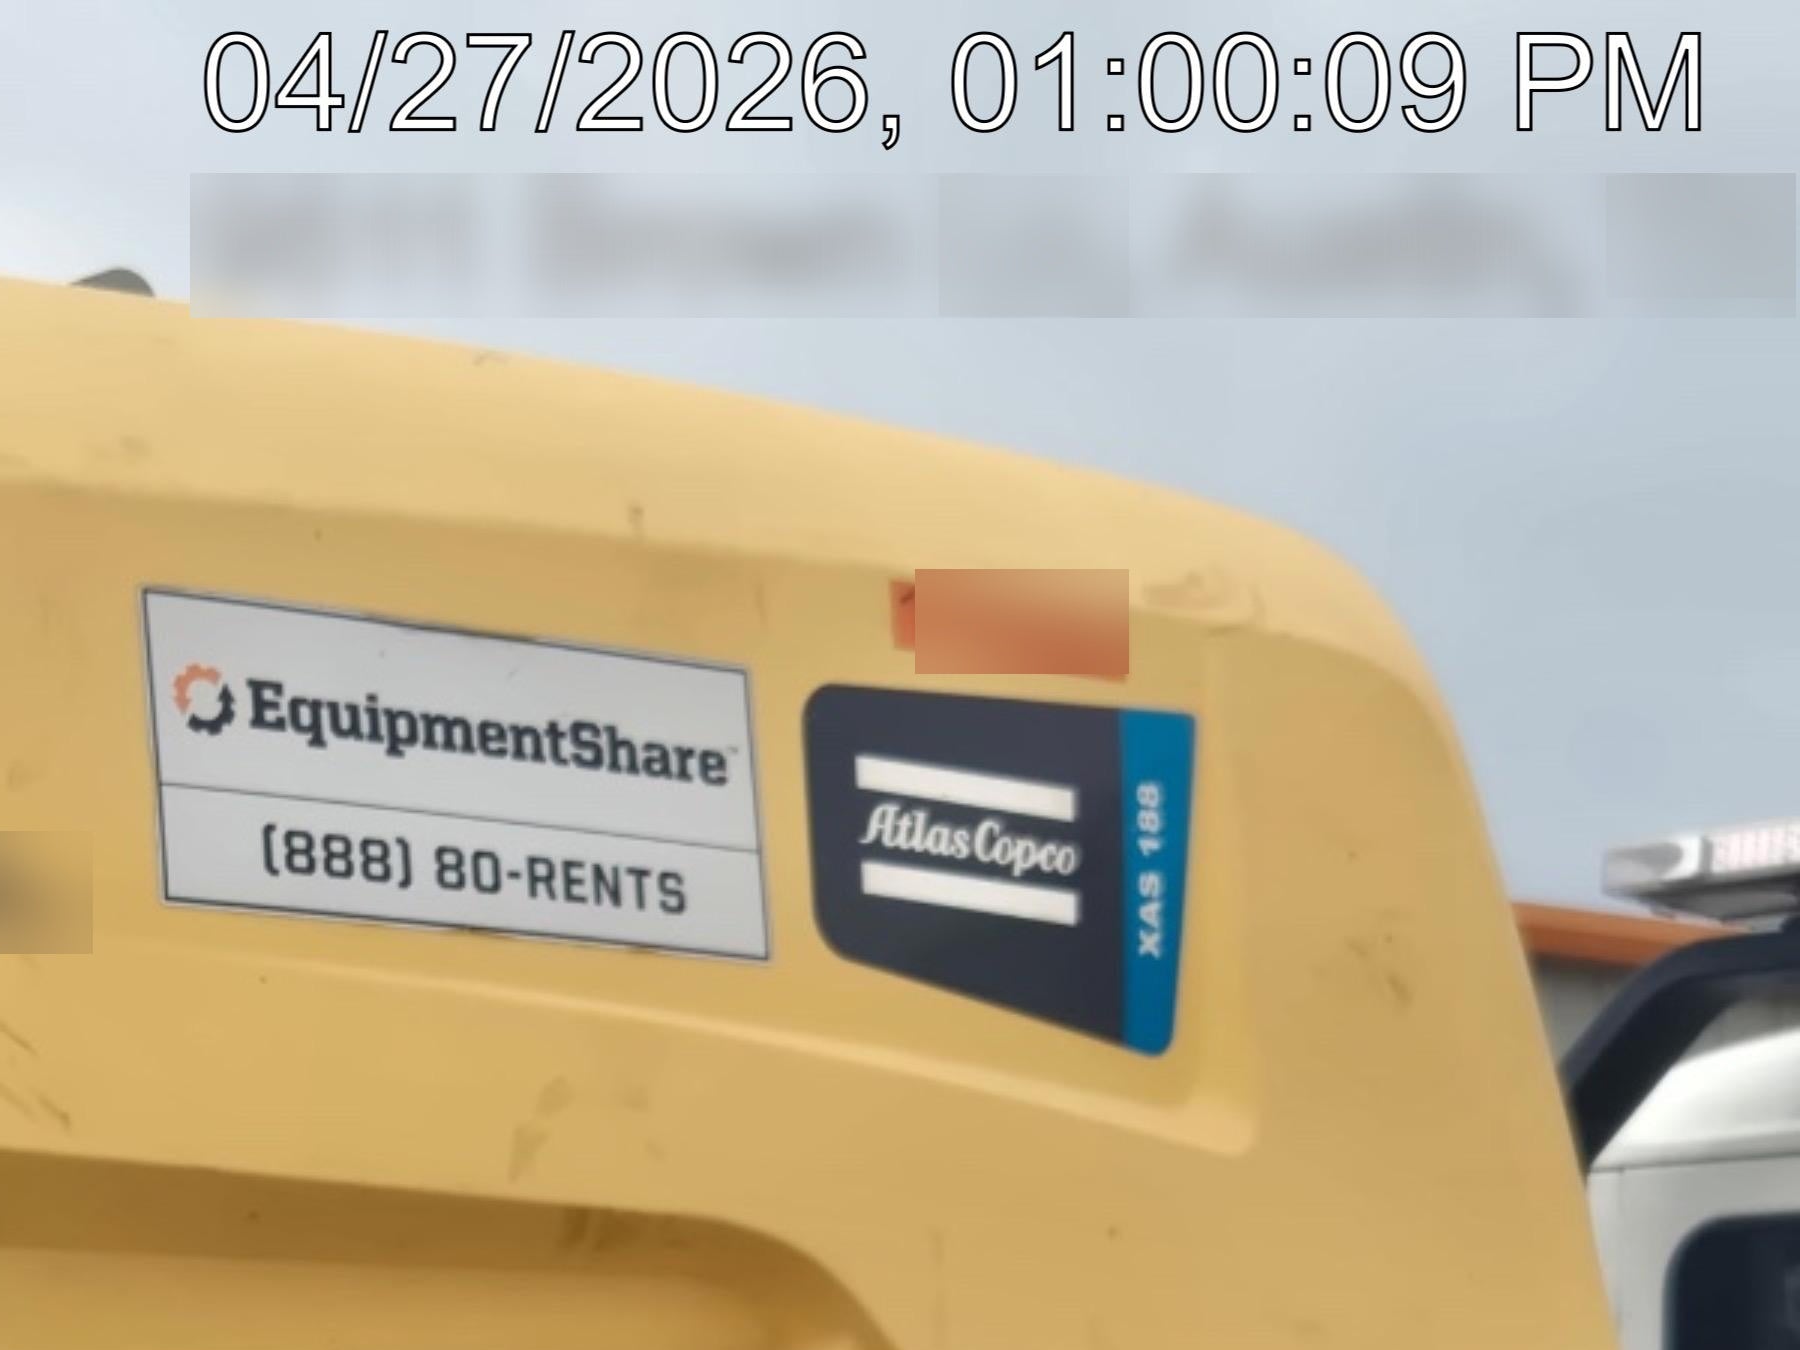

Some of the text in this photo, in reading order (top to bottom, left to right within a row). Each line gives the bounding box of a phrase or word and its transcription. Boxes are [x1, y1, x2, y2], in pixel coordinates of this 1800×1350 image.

[245, 677, 729, 786] EquipmentShare
[261, 822, 688, 915] (888) 80-RENTS
[858, 803, 1078, 877] Atlas Copco
[1136, 782, 1163, 960] XAS 188
